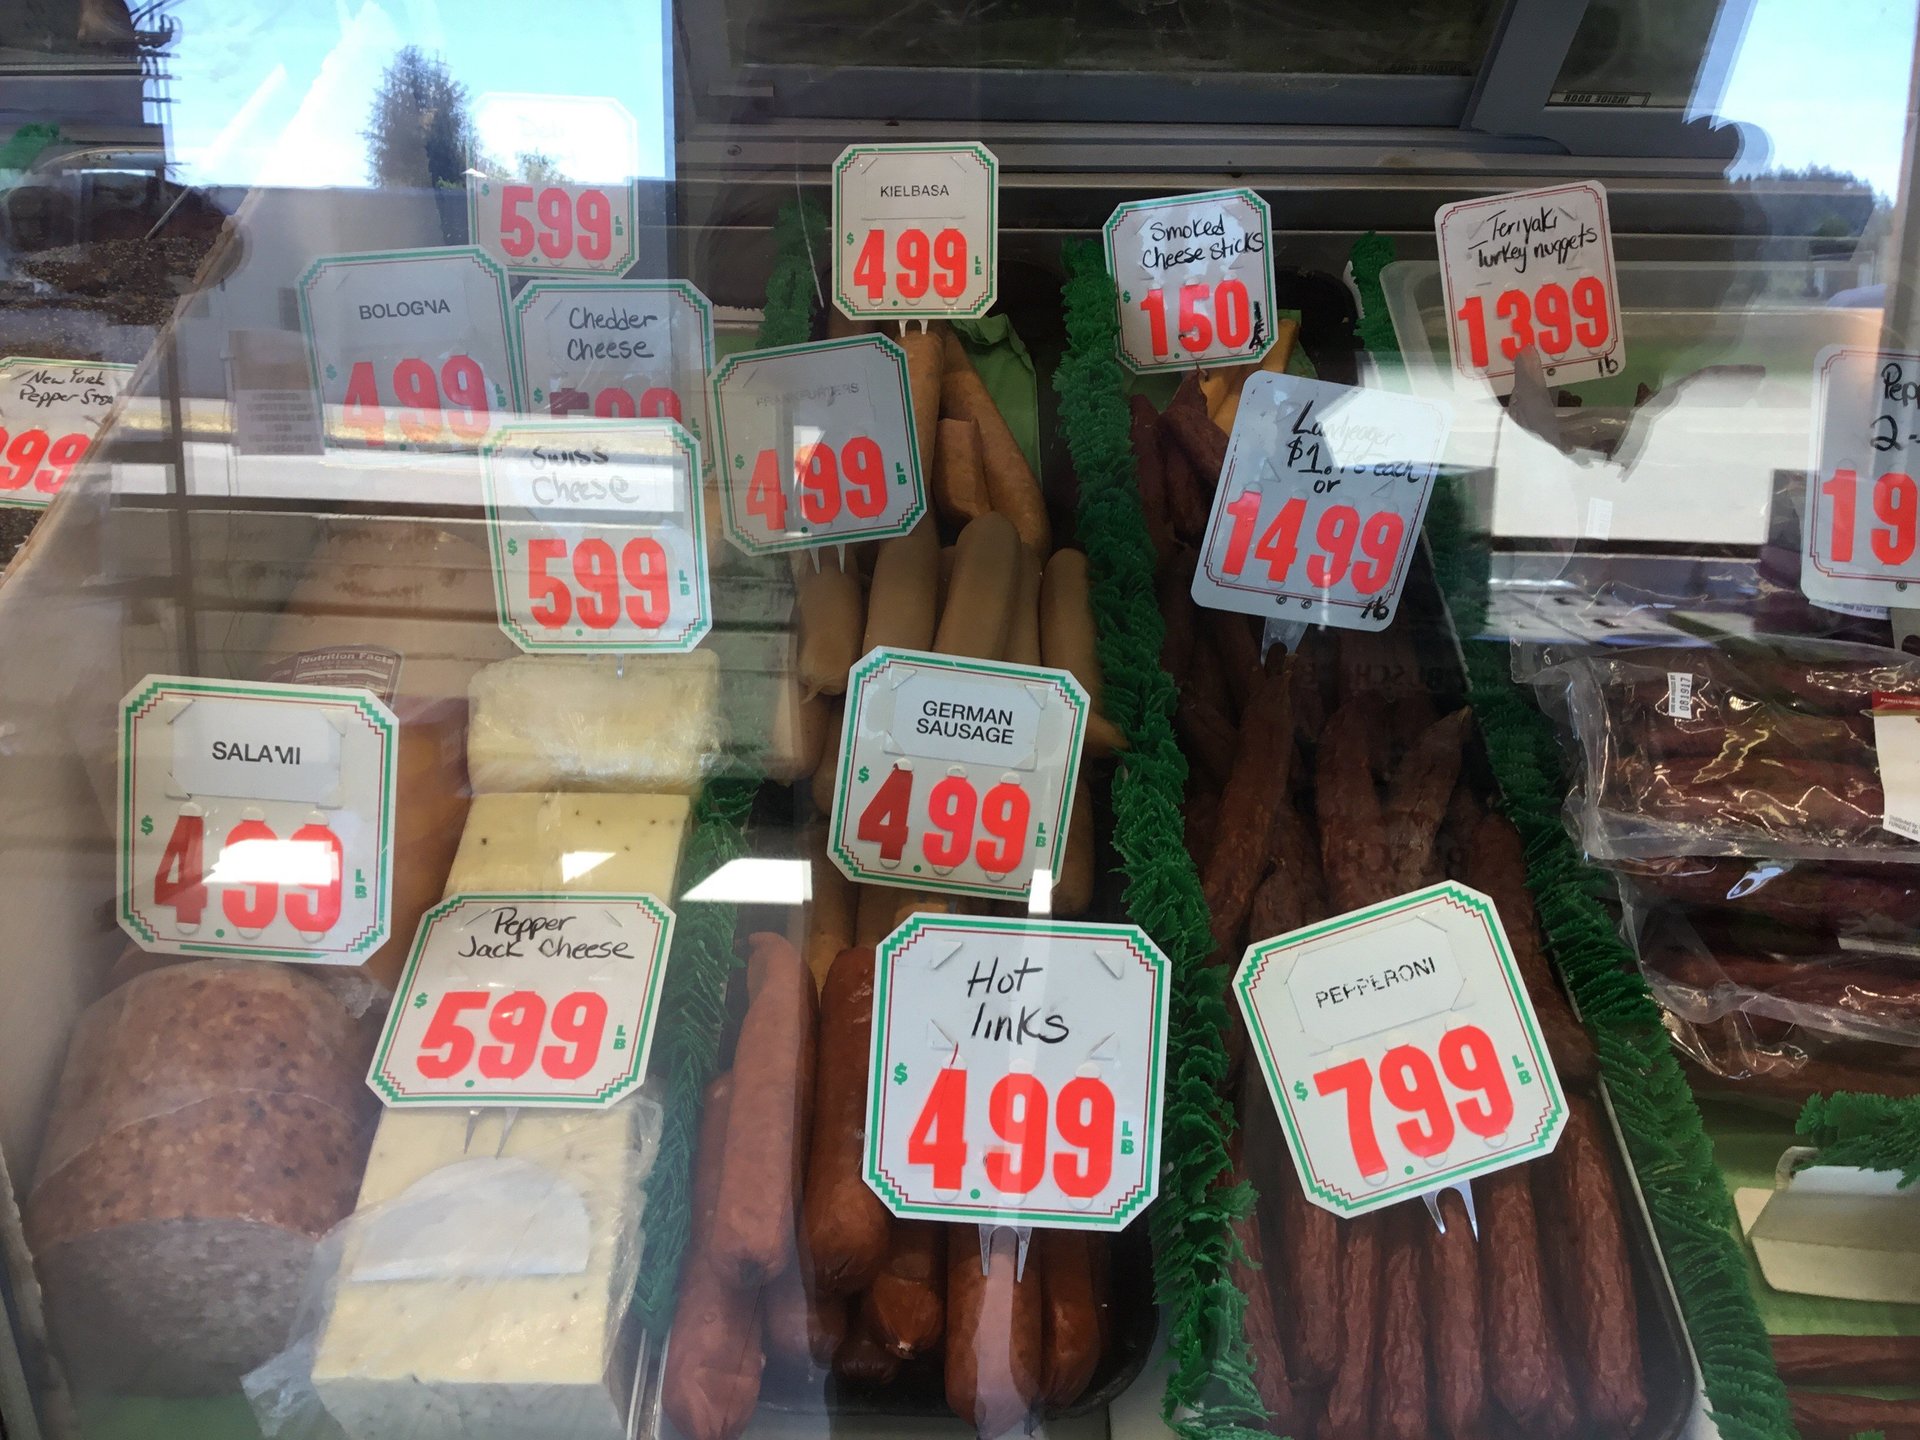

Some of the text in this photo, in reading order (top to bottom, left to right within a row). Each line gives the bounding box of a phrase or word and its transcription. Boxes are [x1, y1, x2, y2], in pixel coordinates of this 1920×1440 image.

[879, 184, 950, 198] KIELBASA
[1150, 213, 1225, 241] Smoked
[1487, 206, 1558, 243] Teriyaki
[1468, 223, 1598, 274] Turkey nuggets
[359, 299, 451, 320] BOLOGNA
[569, 307, 658, 330] Chedder
[567, 338, 655, 361] Cheese
[27, 370, 65, 384] New
[20, 383, 78, 408] Pepper
[1313, 479, 1342, 494] or
[301, 652, 394, 665] Nutrition Facts
[922, 700, 1013, 726] GERMAN
[916, 718, 1015, 745] SAUSAGE
[212, 741, 301, 765] SALAMI
[491, 907, 577, 940] Pepper
[458, 935, 635, 960] Jack Cheese
[967, 957, 1044, 997] Hot
[1315, 956, 1437, 1009] PEPPERONI
